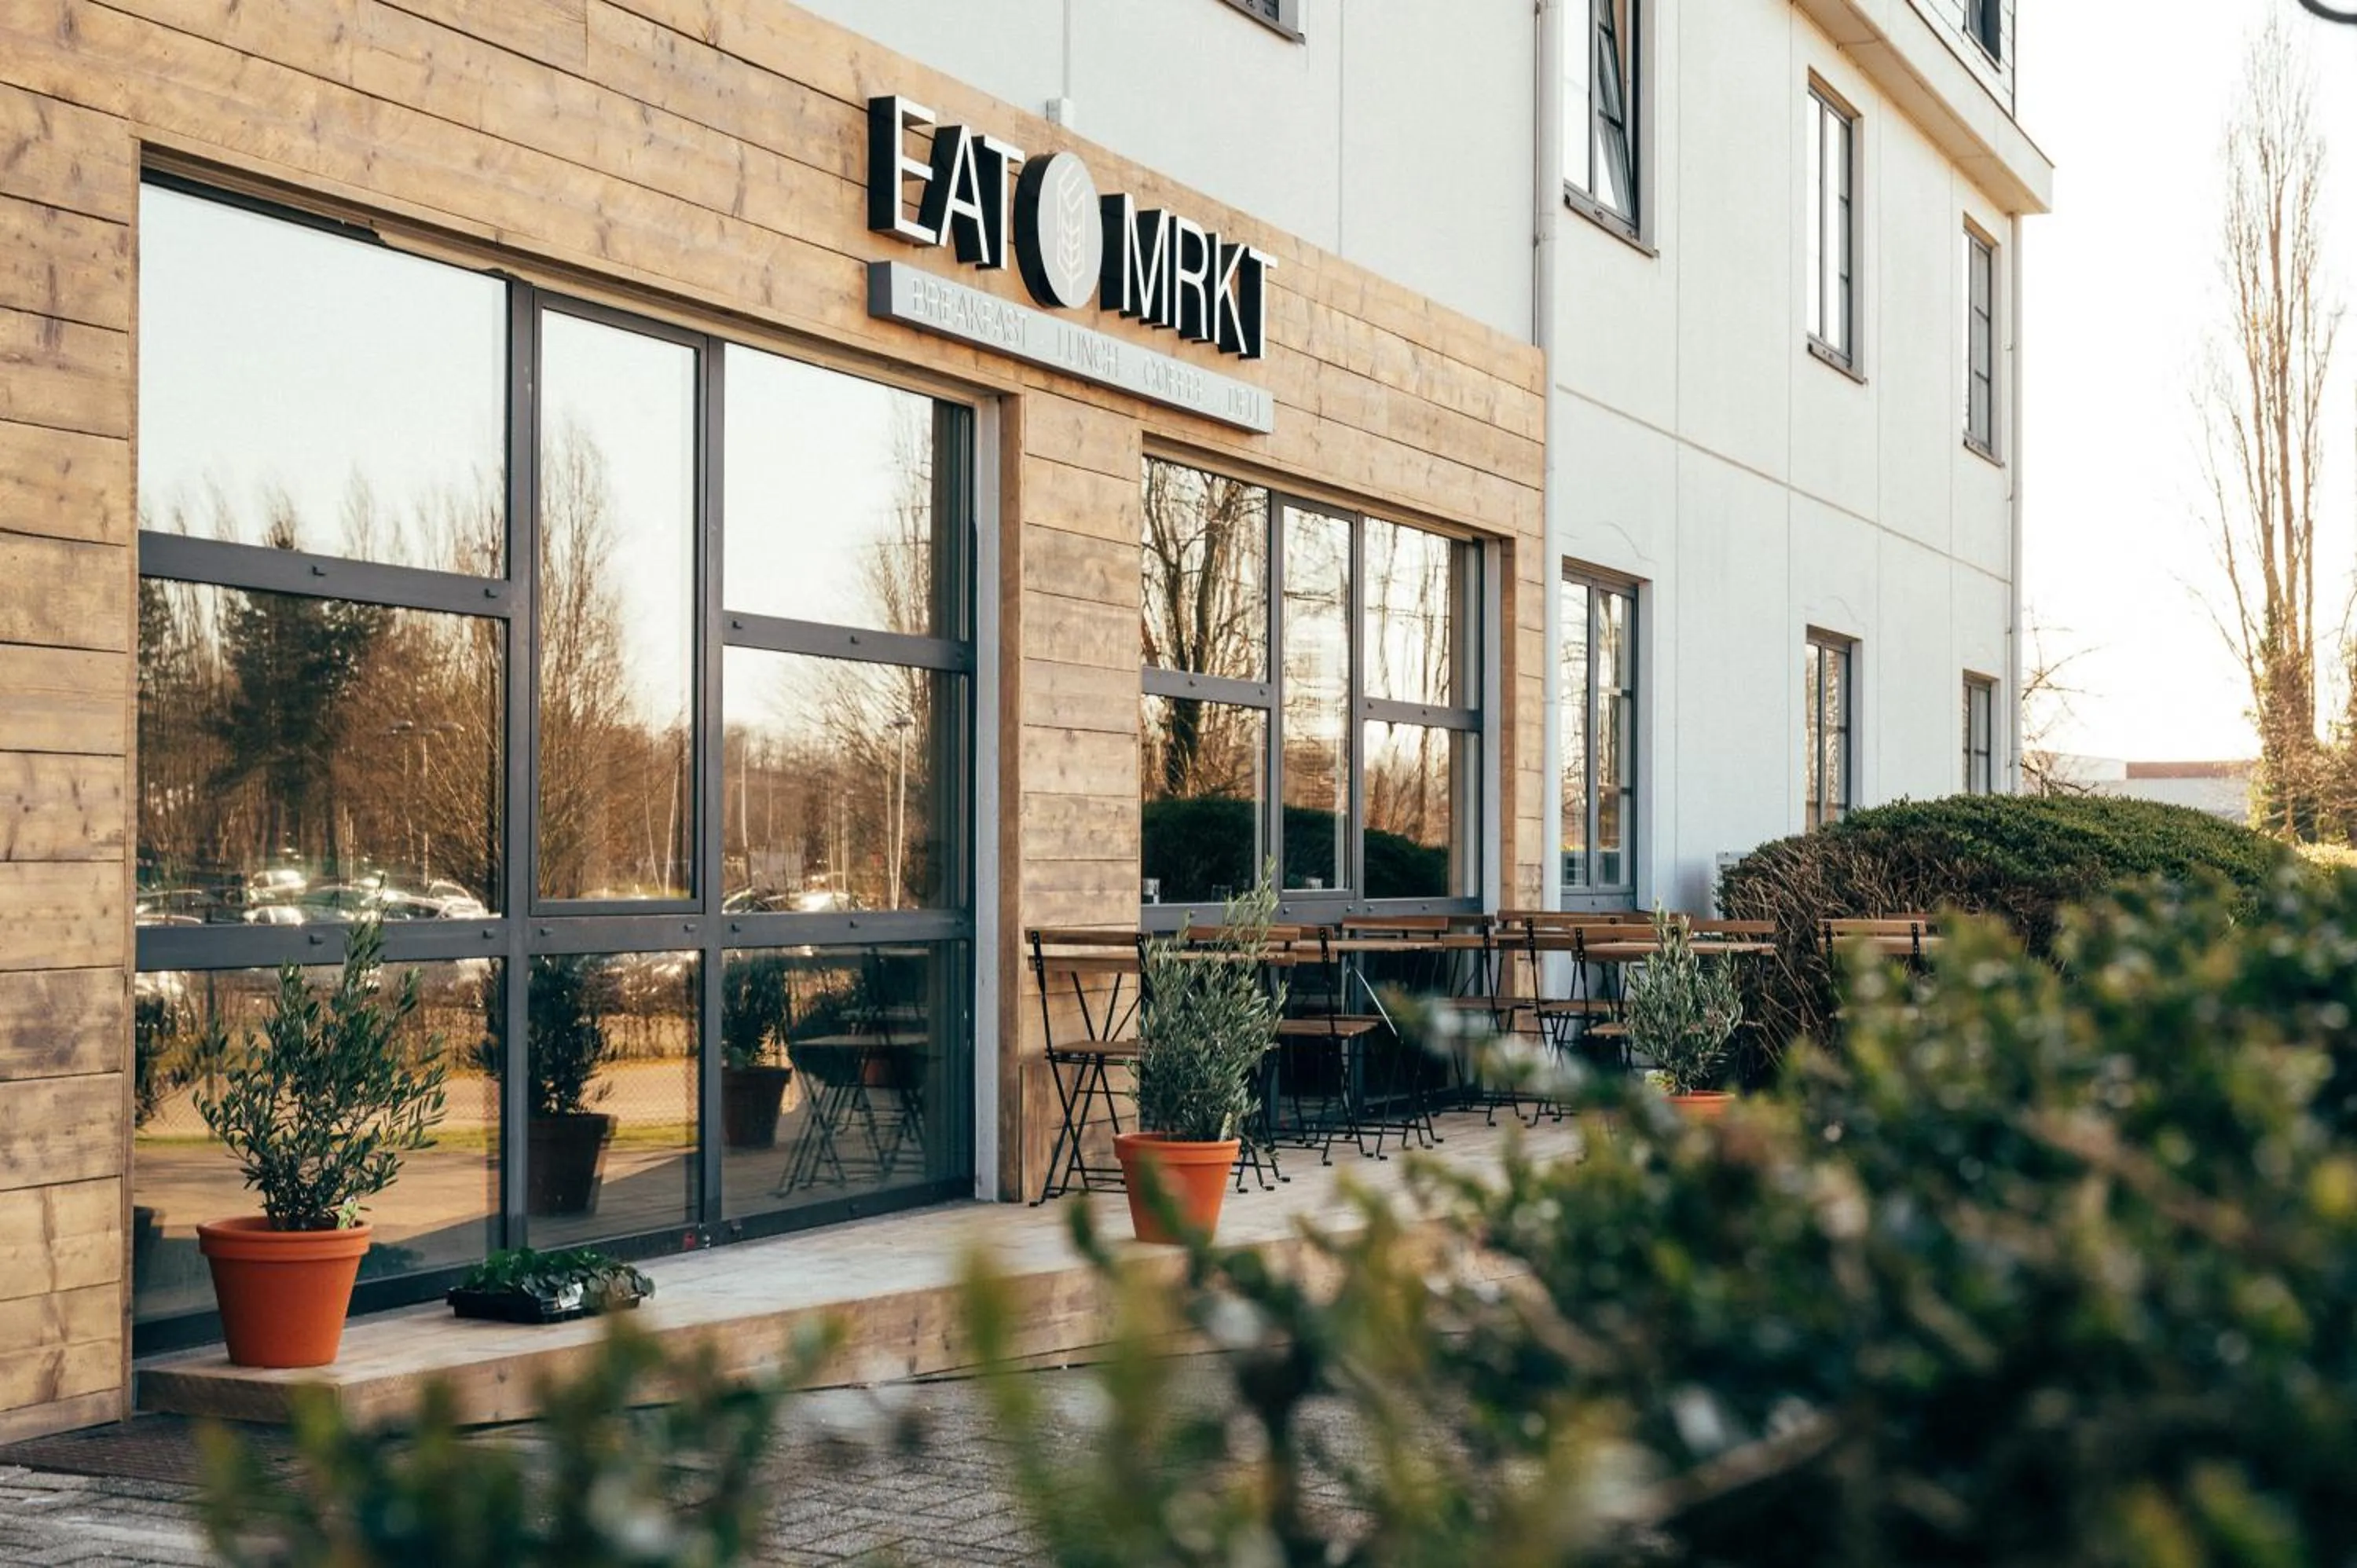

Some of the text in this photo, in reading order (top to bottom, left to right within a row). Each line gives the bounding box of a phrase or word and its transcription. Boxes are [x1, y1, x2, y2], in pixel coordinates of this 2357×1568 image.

[889, 94, 1278, 361] EAT MRKT
[911, 277, 1263, 426] BREAKFAST LUNCH COFFEE DELI
